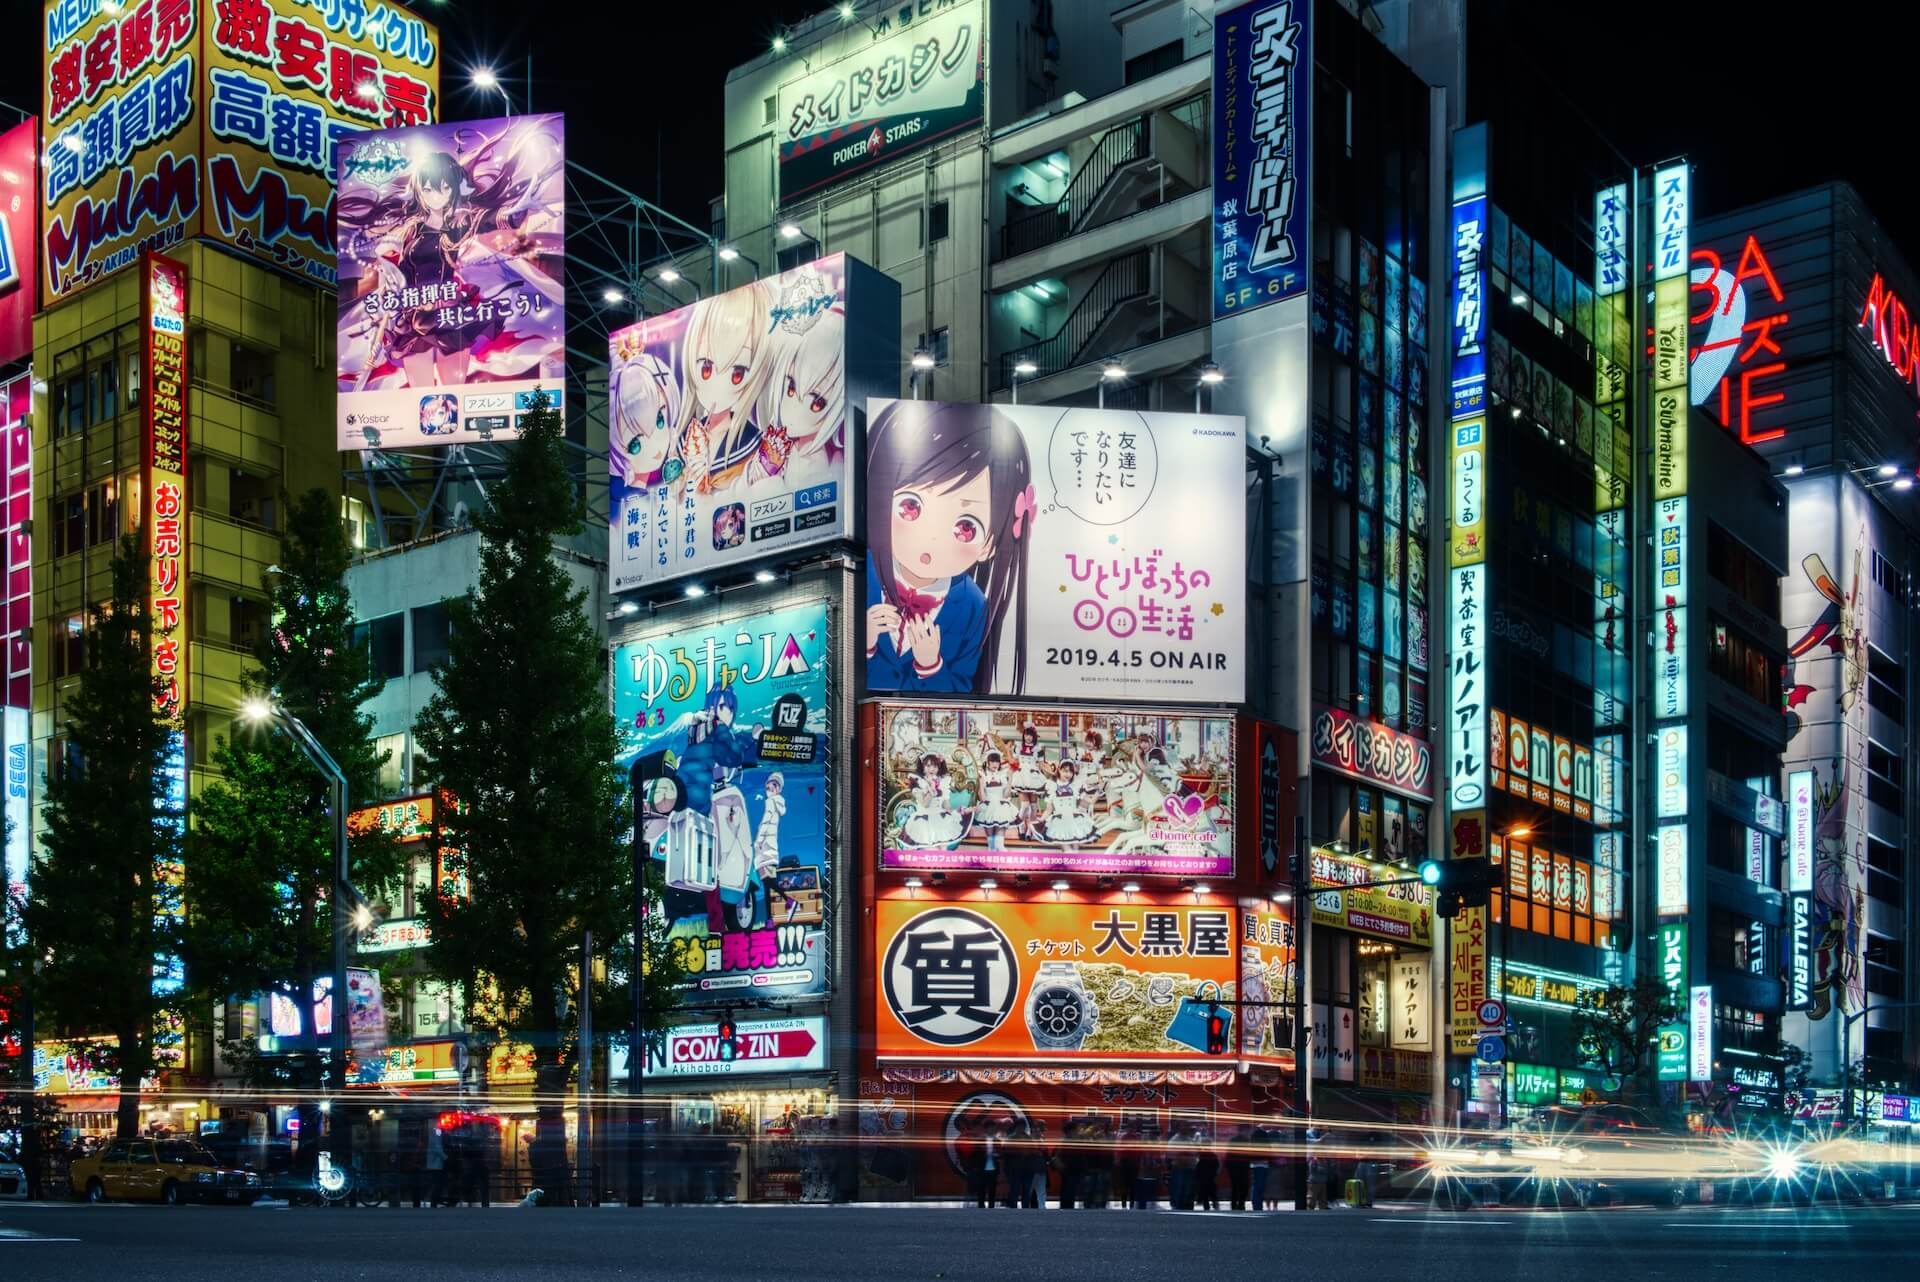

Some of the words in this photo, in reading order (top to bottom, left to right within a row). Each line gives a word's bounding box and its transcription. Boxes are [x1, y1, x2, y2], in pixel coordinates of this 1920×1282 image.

[787, 24, 972, 142] メイドカジノ
[833, 140, 867, 166] POKER
[885, 117, 921, 145] STARS
[47, 150, 199, 295] Mulan
[1661, 176, 1684, 269] スーパービル
[1222, 198, 1238, 282] 秋葉原店
[103, 244, 136, 274] AKIBA
[154, 316, 182, 332] あなたの
[154, 334, 181, 352] DVD
[1658, 325, 1677, 382] Yellow
[154, 364, 181, 383] ゲーム
[158, 380, 177, 396] CD
[154, 394, 181, 414] アイドル
[467, 398, 506, 409] アズレン
[153, 409, 181, 427] アニメ
[357, 414, 390, 424] Yostar
[154, 426, 181, 443] コミック
[1460, 429, 1478, 443] 3F
[1659, 396, 1678, 490] Submarine
[155, 441, 180, 457] ホビー
[1118, 431, 1137, 488] 友達に
[1095, 430, 1112, 505] なりたい
[1463, 455, 1476, 523] りらくる
[685, 481, 696, 558] これが君の
[754, 501, 787, 518] アズレン
[1662, 502, 1680, 513] 5F
[1065, 549, 1211, 600] ひとりぼっちの
[1046, 647, 1143, 667] 2019.4.5
[1150, 650, 1184, 669] ON
[1189, 651, 1227, 670] AIR
[1313, 711, 1430, 790] メイドカジノ
[9, 742, 26, 799] SEGA
[1151, 831, 1192, 842] @home
[1193, 830, 1217, 842] cafe
[1092, 909, 1231, 958] 大黒屋
[1026, 938, 1085, 955] チケット
[1794, 897, 1809, 1006] GALLERIA
[897, 928, 1006, 1029] 質
[1404, 978, 1419, 1039] ルノアール
[1483, 1006, 1498, 1020] 40
[674, 1038, 744, 1062] COMC
[749, 1034, 780, 1058] ZIN
[1483, 1043, 1494, 1060] P
[673, 1062, 732, 1074] Akihabara
[1516, 1073, 1556, 1095] リバティー
